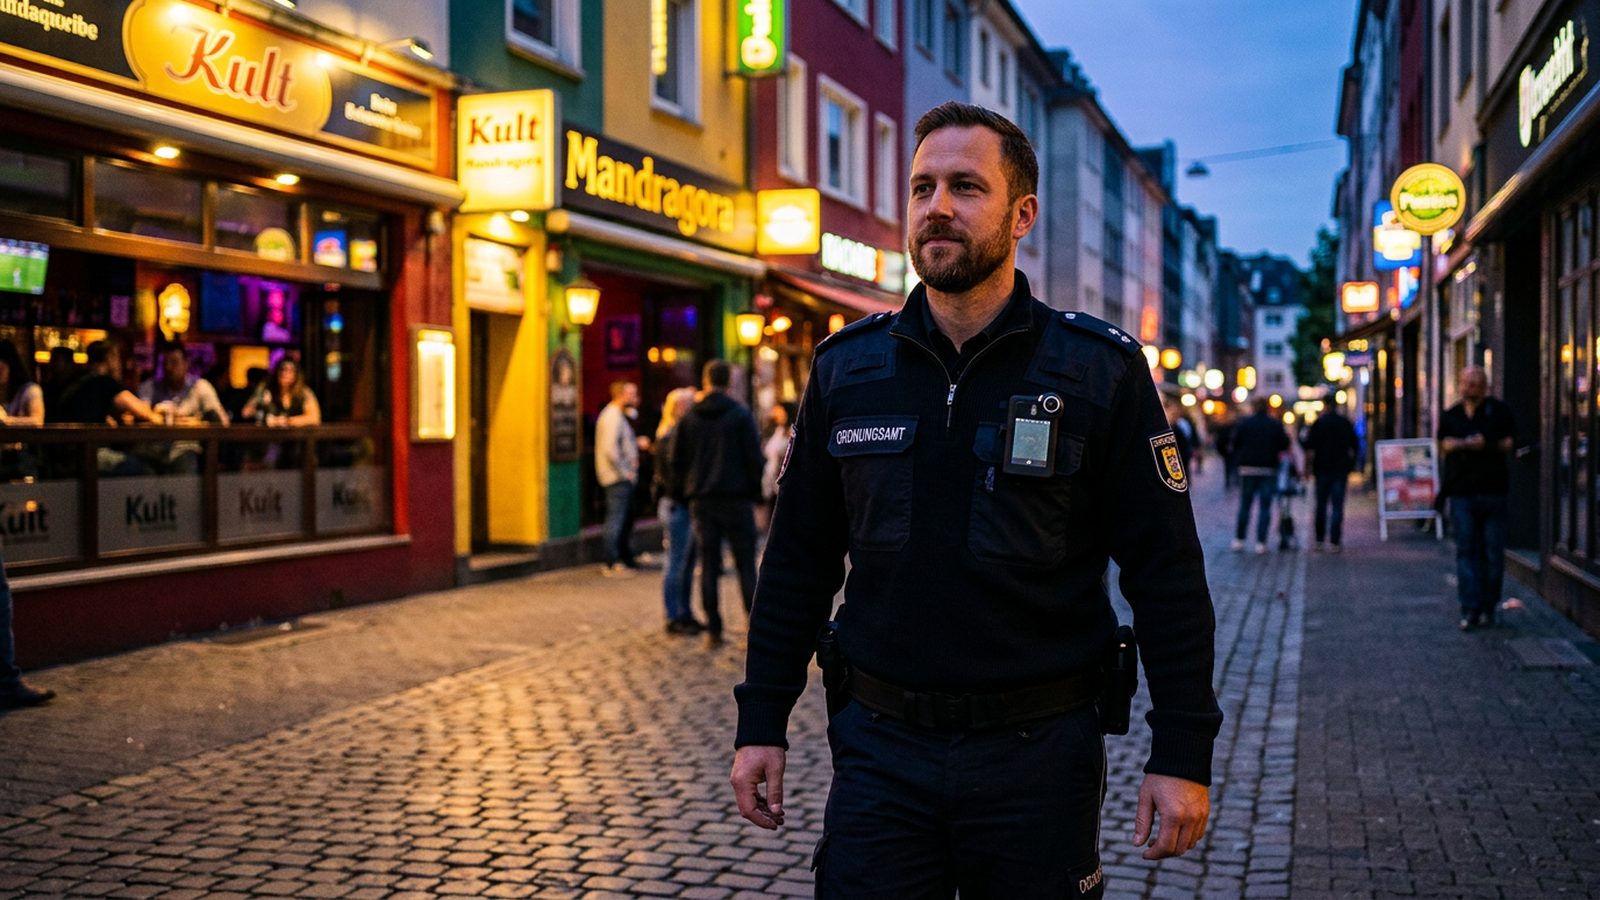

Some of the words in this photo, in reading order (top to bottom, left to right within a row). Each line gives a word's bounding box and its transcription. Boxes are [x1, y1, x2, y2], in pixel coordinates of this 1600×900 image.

[165, 24, 297, 110] Kult
[469, 113, 542, 145] Kult
[565, 129, 734, 237] Mandragora
[836, 426, 906, 445] ORDNUNGSAMT
[125, 493, 178, 525] Kult
[239, 487, 283, 519] Kult
